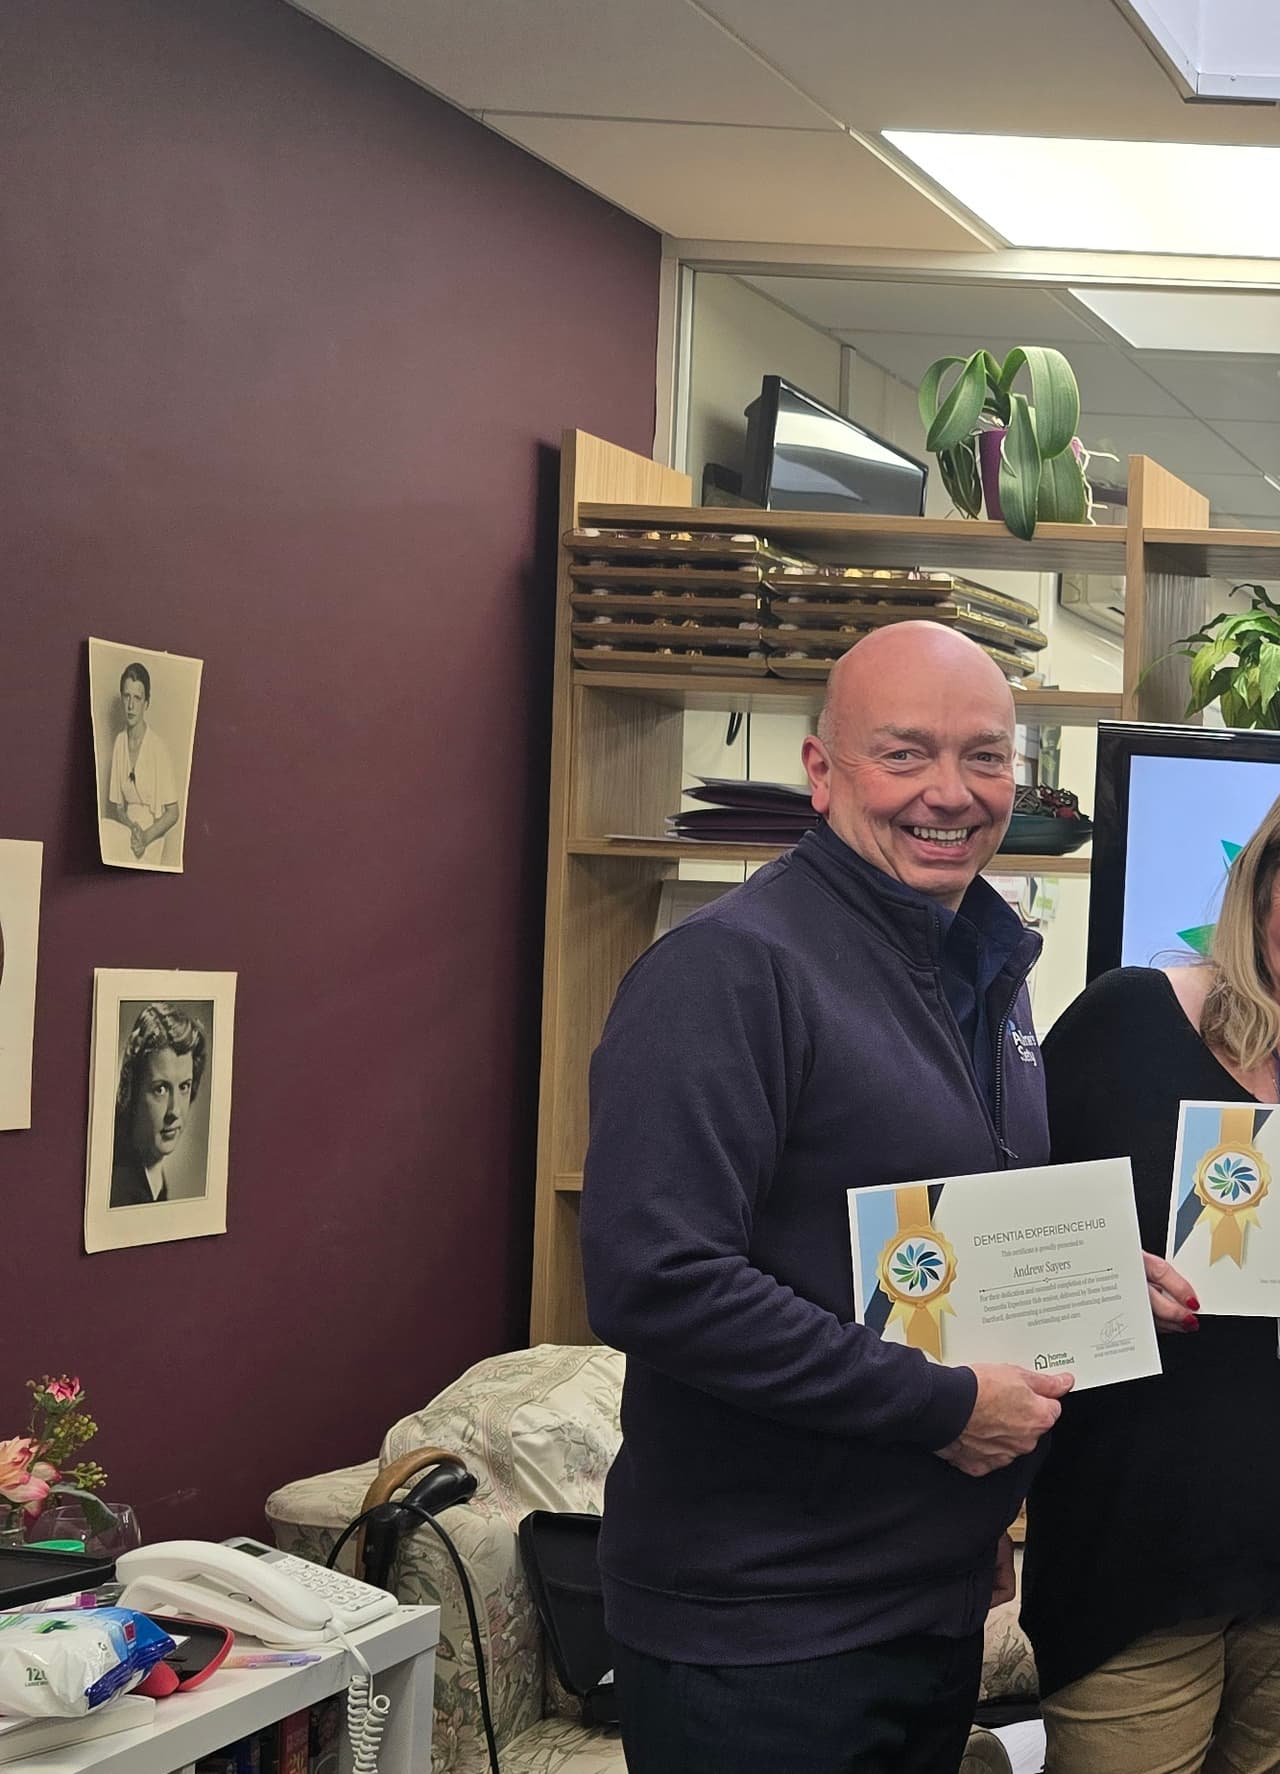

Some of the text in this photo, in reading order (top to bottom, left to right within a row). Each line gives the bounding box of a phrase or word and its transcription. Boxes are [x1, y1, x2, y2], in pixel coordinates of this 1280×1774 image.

[973, 1218, 1106, 1247] DEMENTIA EXPERIENCE HUB
[1013, 1260, 1072, 1279] Andrew Sayers
[1048, 1352, 1067, 1360] home
